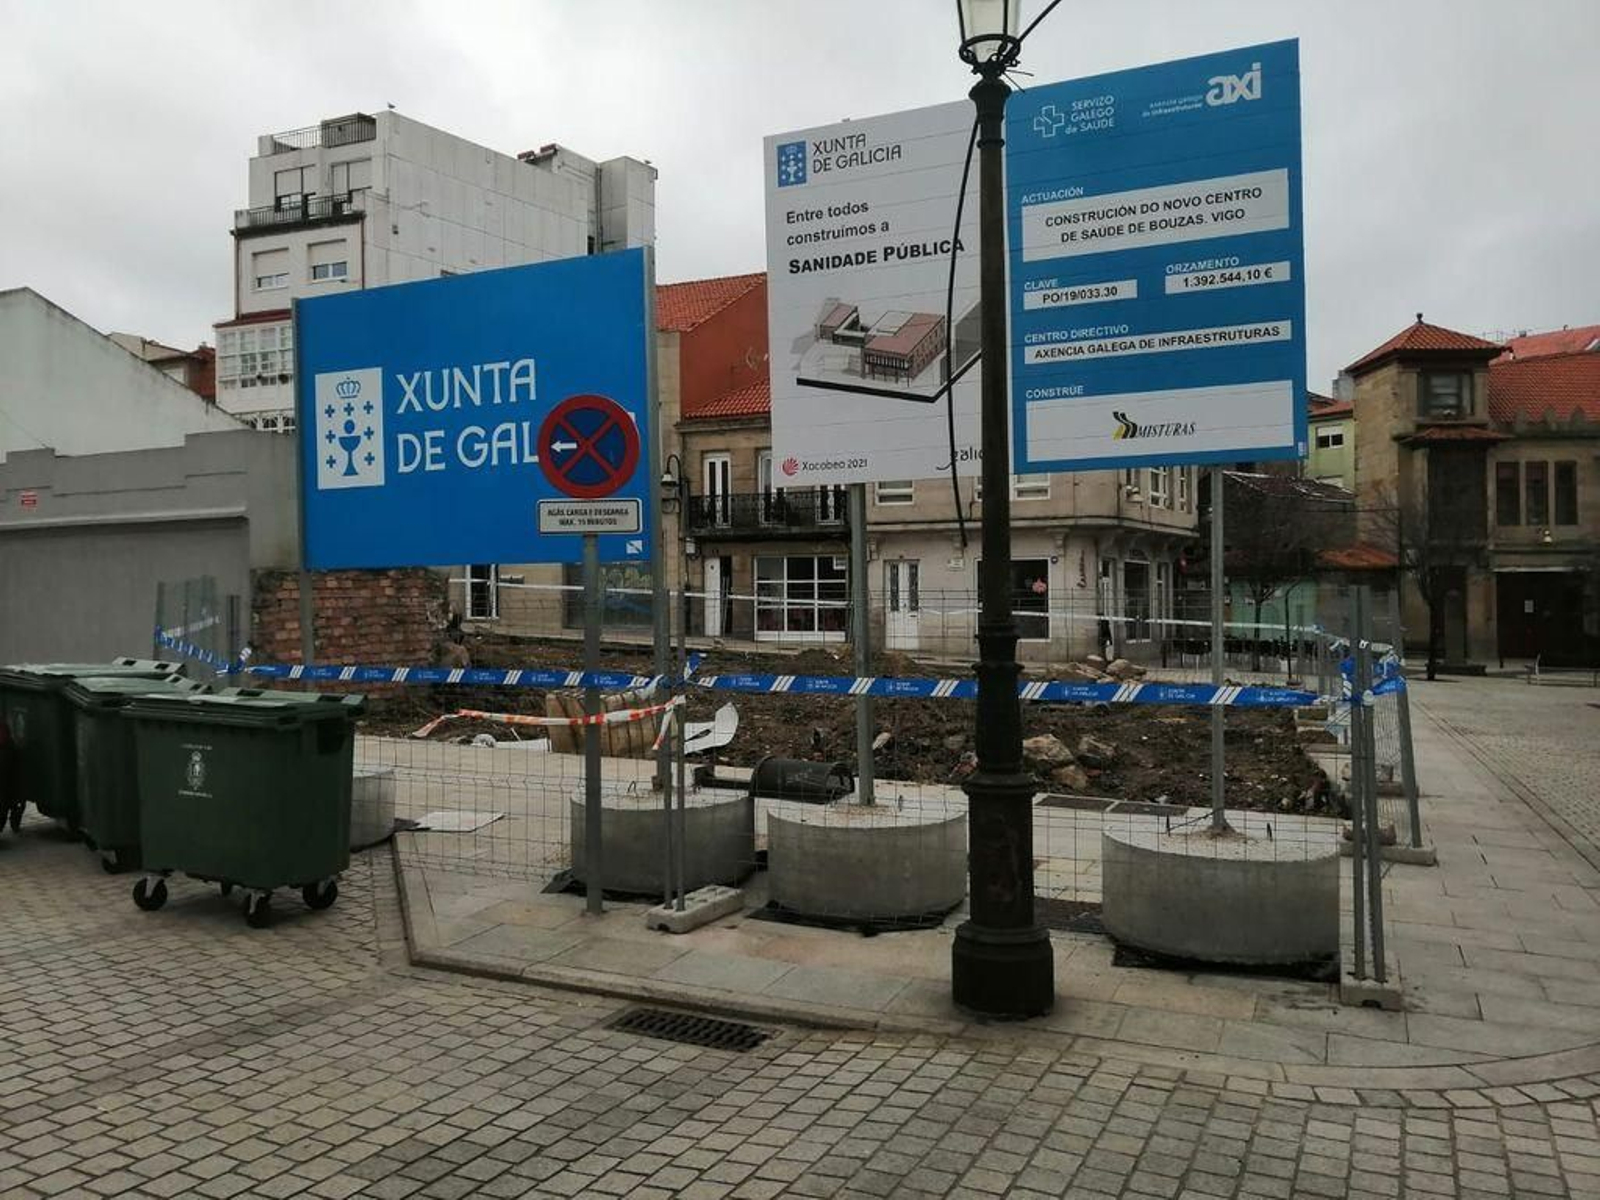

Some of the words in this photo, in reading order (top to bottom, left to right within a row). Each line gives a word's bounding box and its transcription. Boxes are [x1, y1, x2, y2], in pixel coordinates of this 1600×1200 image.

[1205, 62, 1262, 107] axi
[1072, 95, 1115, 111] SERVIZO
[1071, 106, 1115, 122] GALEGO
[813, 133, 867, 156] XUNTA
[813, 159, 832, 174] DE
[836, 144, 901, 169] GALICIA
[1022, 186, 1084, 205] ACTUACIÓN
[786, 210, 824, 224] Entre
[827, 202, 869, 218] todos
[1045, 204, 1136, 228] CONSTRUCIÓN
[1140, 201, 1160, 216] DO
[1163, 195, 1202, 212] NOVO
[1205, 187, 1262, 205] CENTRO
[881, 221, 890, 232] a
[1061, 231, 1077, 243] DE
[1128, 222, 1145, 235] DE
[1211, 208, 1246, 223] VIGO
[789, 251, 878, 275] SANIDADE
[883, 239, 965, 262] PÚBLICA
[1166, 257, 1240, 274] ORZAMENTO
[1264, 267, 1273, 279] €
[1024, 278, 1058, 290] CLAVE
[1042, 286, 1118, 304] PO/19/033.30
[1024, 329, 1068, 344] CENTRO
[1070, 324, 1129, 339] DIRECTIVO
[1034, 345, 1085, 359] AXENCIA
[1087, 340, 1136, 355] GALEGA
[1139, 338, 1155, 349] DE
[1158, 326, 1280, 348] INFRAESTRUTURAS
[396, 358, 537, 414] XUNTA
[1025, 385, 1084, 399] CONSTRUE
[1138, 421, 1197, 438] MISTURAS
[398, 430, 446, 474] DE
[848, 458, 868, 469] 2021
